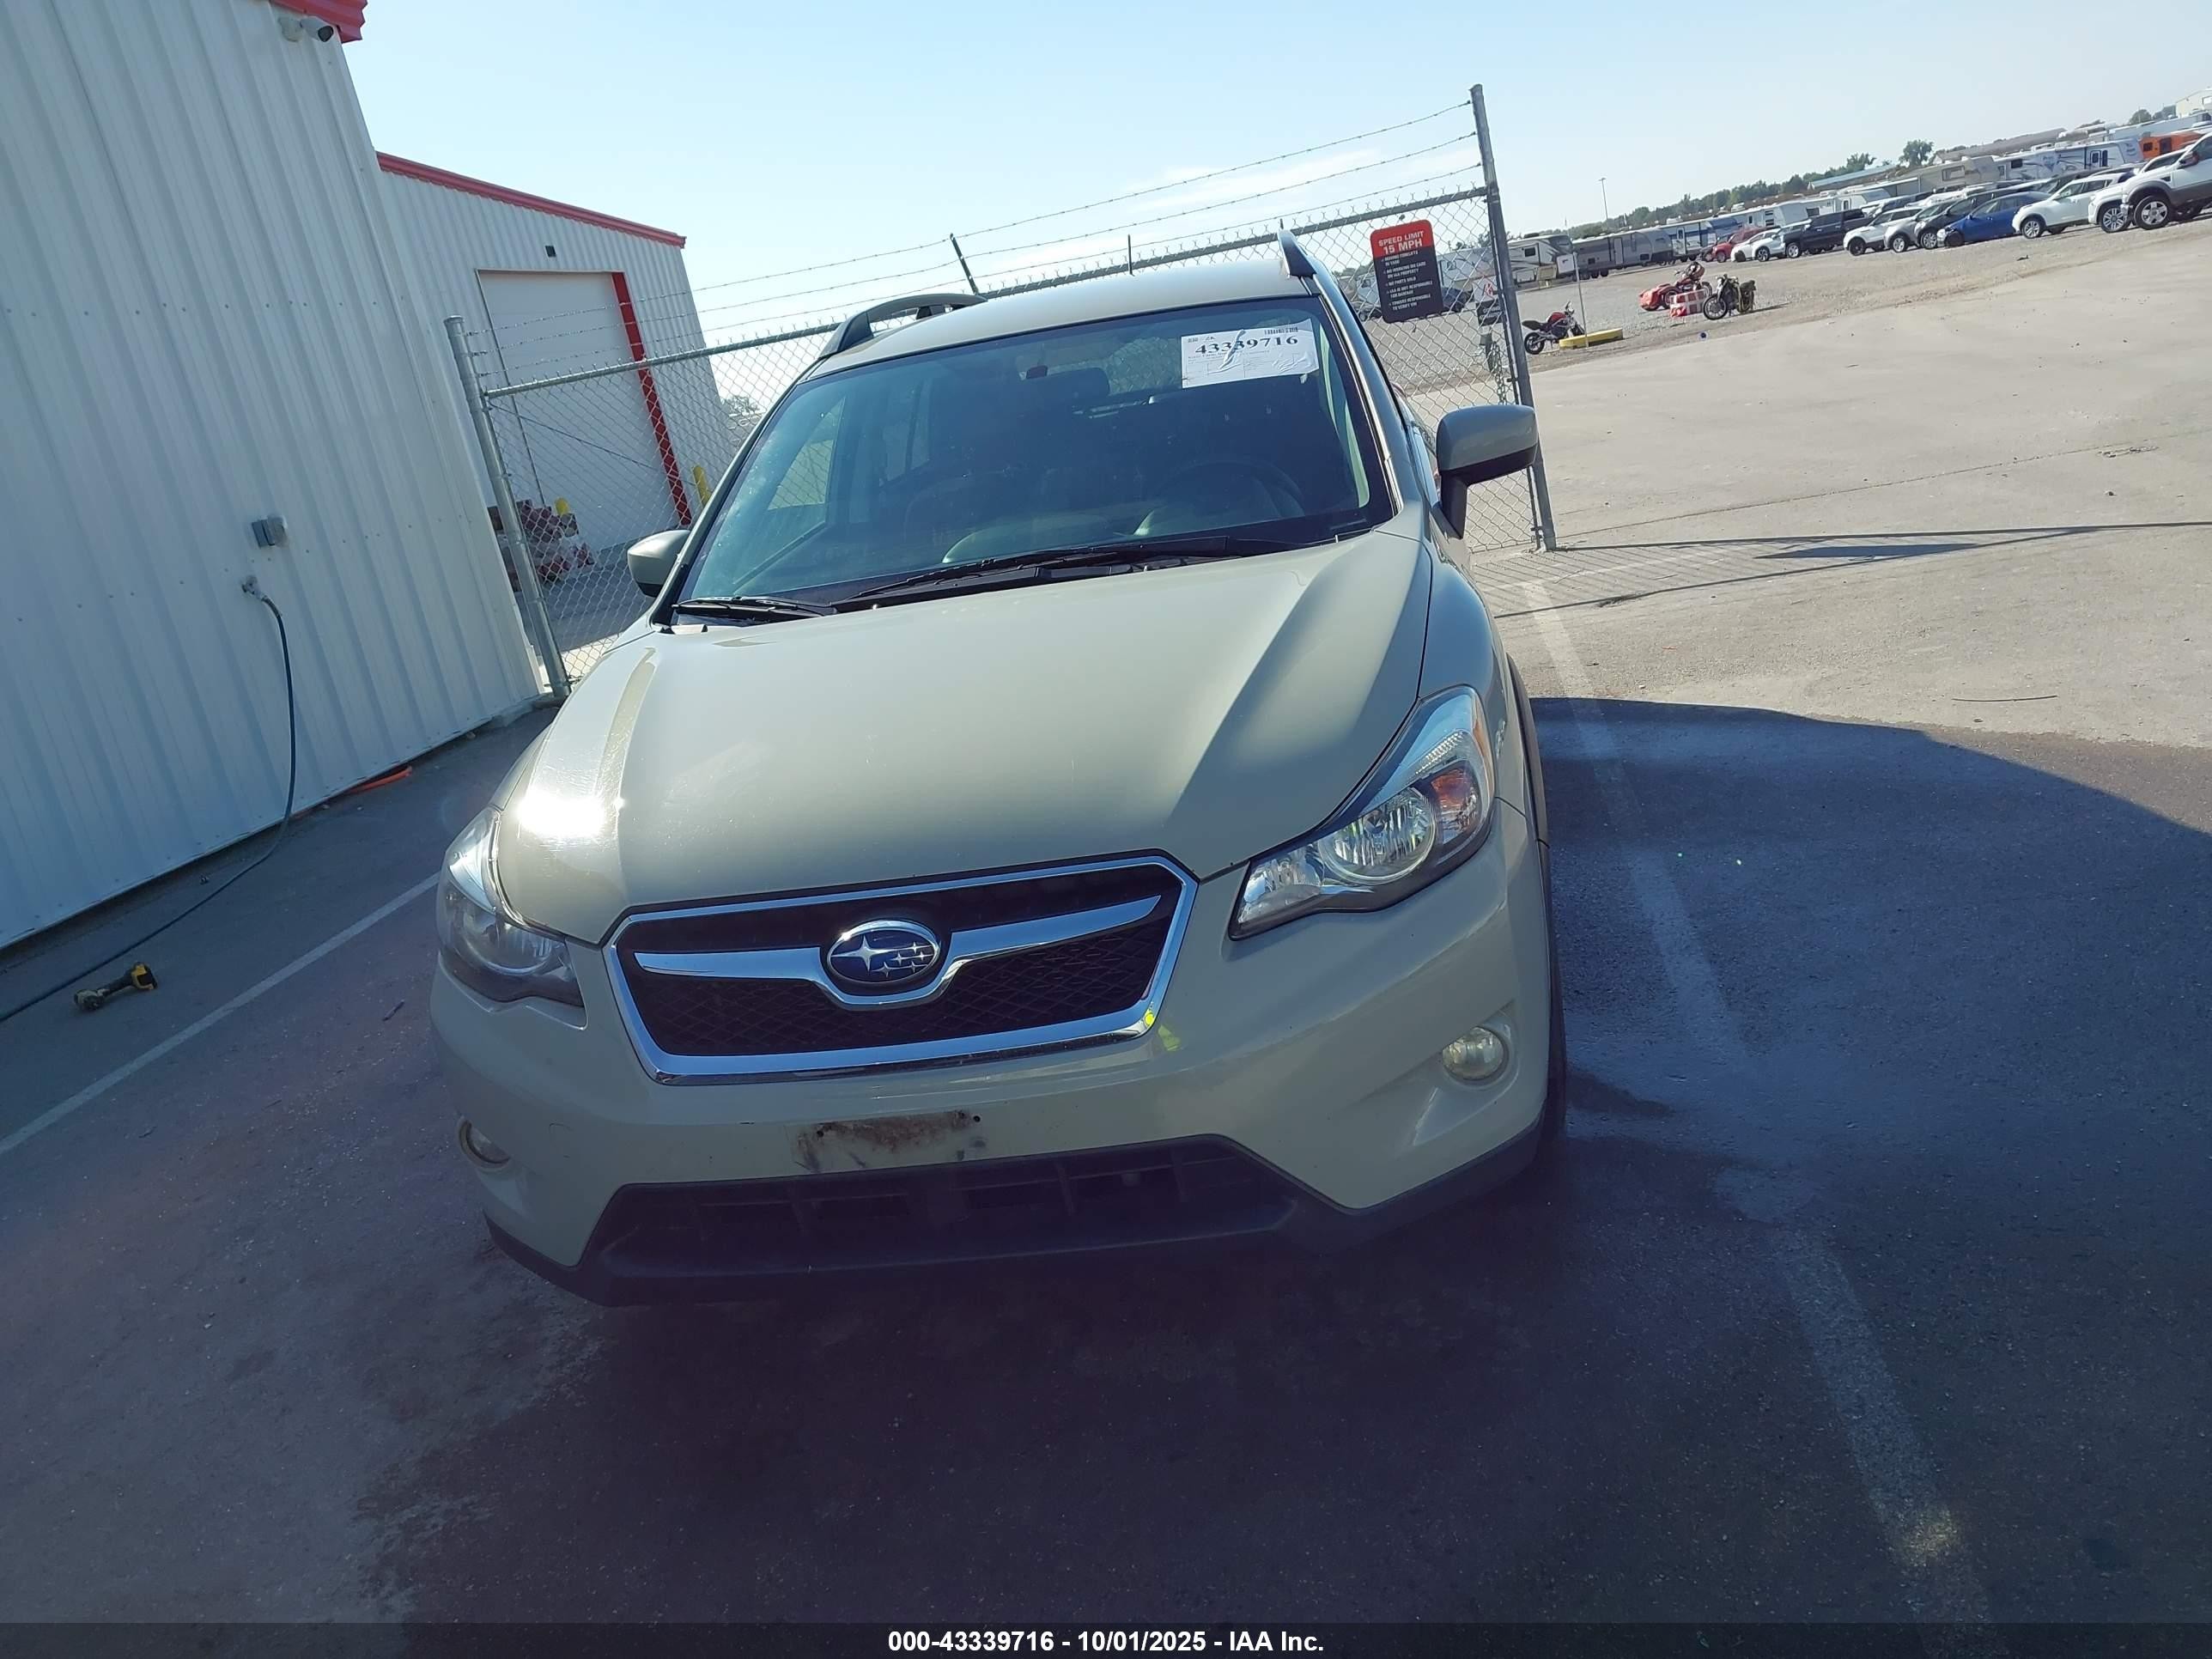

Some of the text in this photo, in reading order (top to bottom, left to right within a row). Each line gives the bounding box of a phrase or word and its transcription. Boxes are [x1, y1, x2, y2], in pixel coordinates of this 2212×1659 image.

[1378, 230, 1425, 246] SPEED LIMIT
[1383, 238, 1423, 255] 15 MPH
[1194, 335, 1298, 355] 43339716
